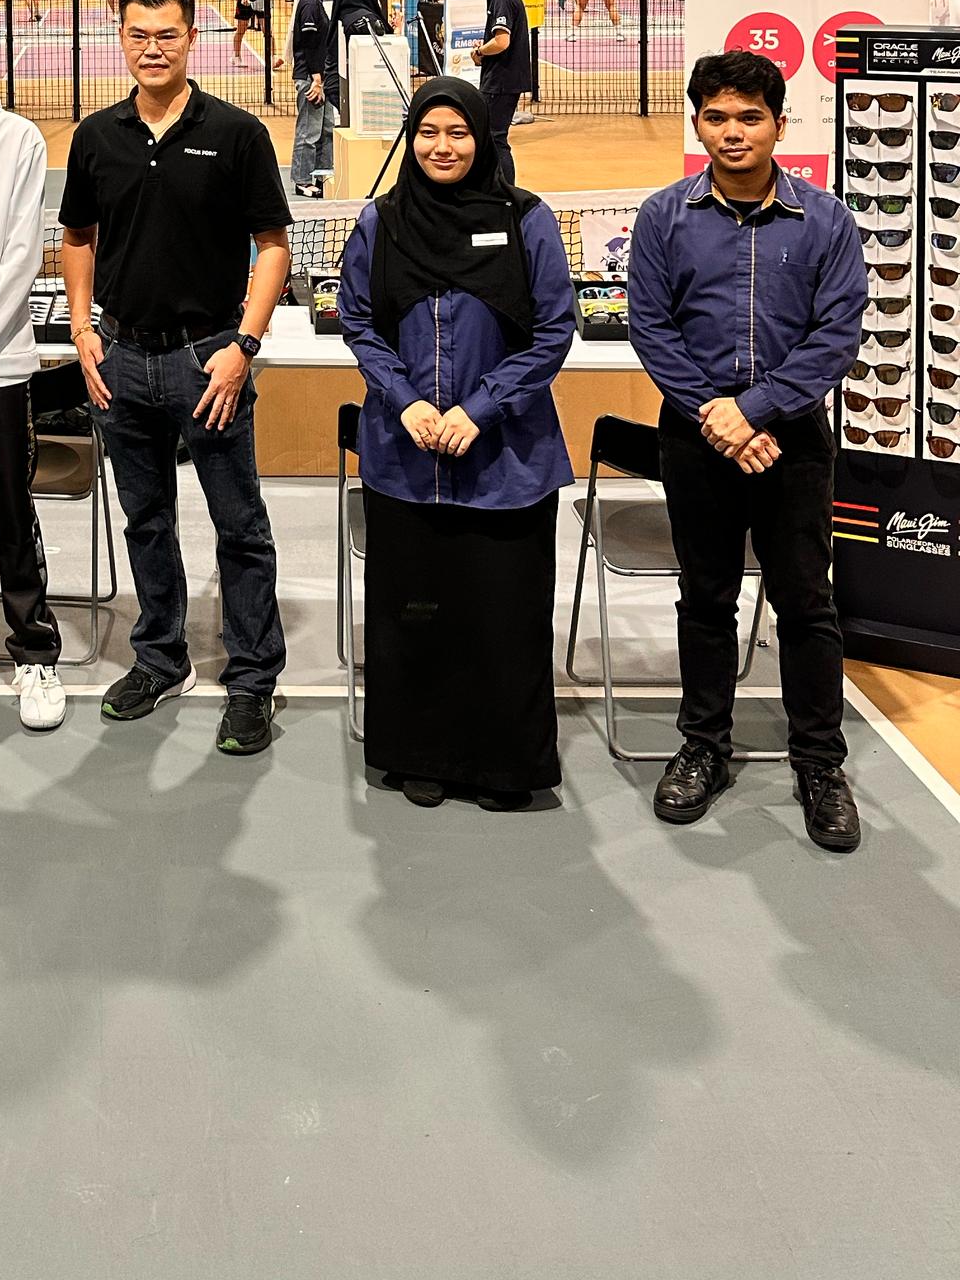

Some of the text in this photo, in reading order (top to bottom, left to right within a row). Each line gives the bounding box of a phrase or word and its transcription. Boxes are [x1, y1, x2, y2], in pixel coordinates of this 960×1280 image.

[749, 29, 779, 50] 35
[873, 43, 918, 51] ORACLE
[820, 95, 834, 103] For
[886, 511, 951, 540] Maui Jim
[886, 540, 951, 557] SUNGLASSES
